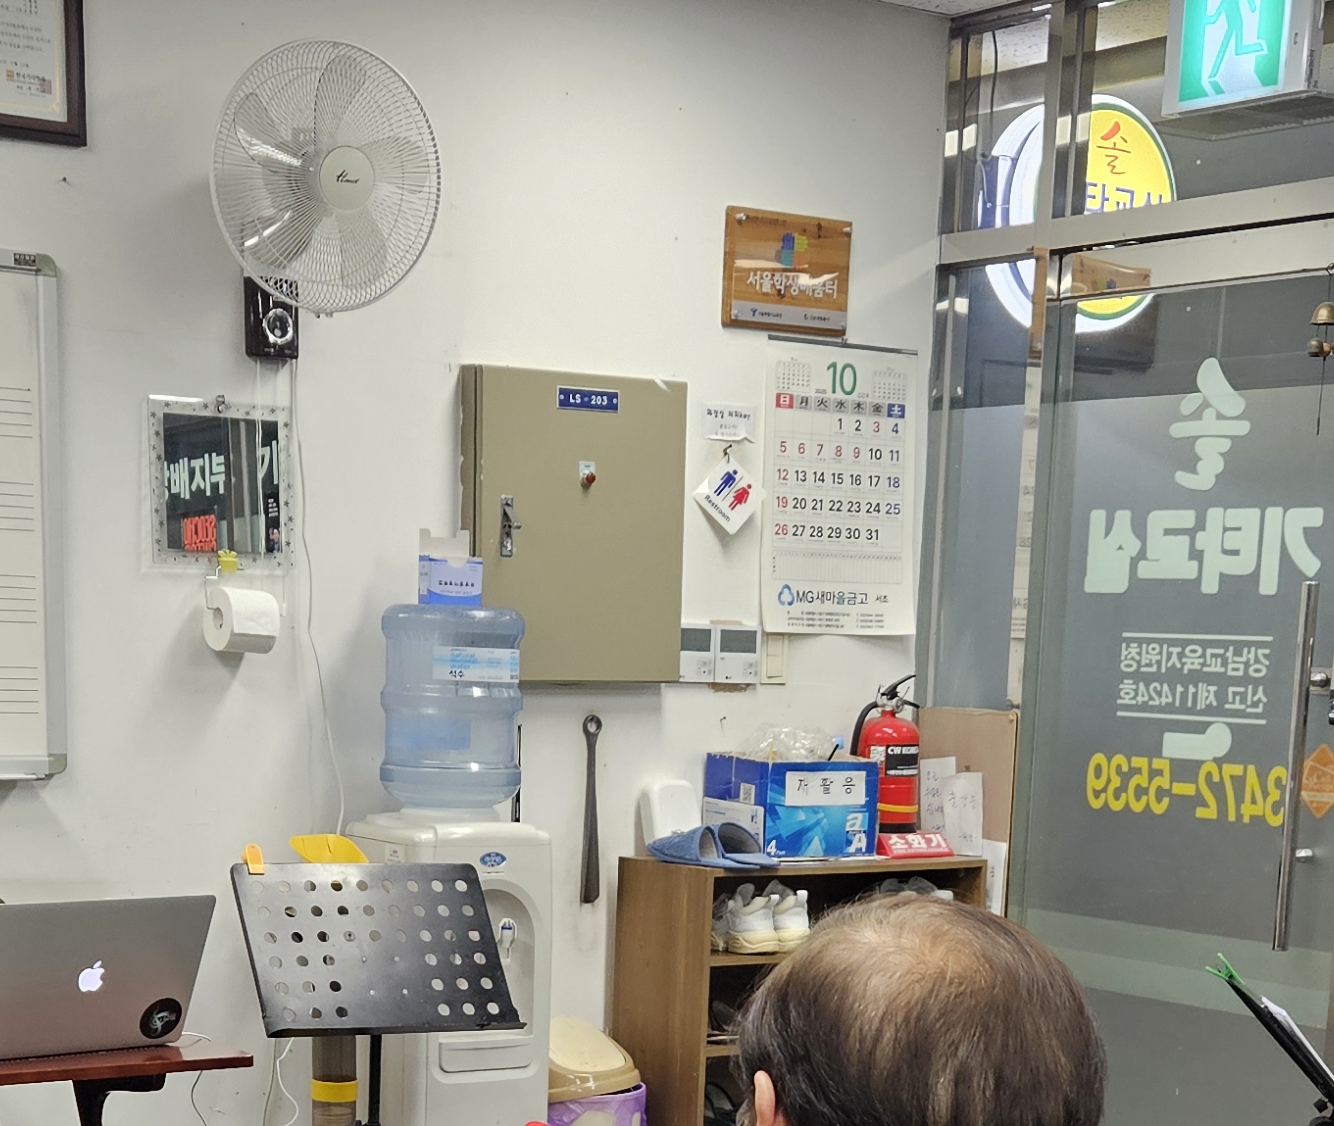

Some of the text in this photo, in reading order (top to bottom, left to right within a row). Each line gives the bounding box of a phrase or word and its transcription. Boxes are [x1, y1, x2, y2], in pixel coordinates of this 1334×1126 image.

[1096, 121, 1131, 174] 솔
[826, 361, 857, 396] 10
[569, 393, 608, 406] LS 203
[780, 394, 903, 416] 日 月 火 水 木 金 土
[838, 418, 899, 435] 1 2 3 4
[780, 441, 900, 462] 5 6 7 8 9 10 11
[777, 468, 900, 489] 12 13 14 15 16 17 18
[704, 494, 730, 523] Restroom
[776, 495, 901, 515] 19 20 21 22 23 24 25
[774, 523, 879, 541] 26 27 28 29 30 31
[767, 839, 777, 856] 4
[888, 833, 947, 850] 소화기
